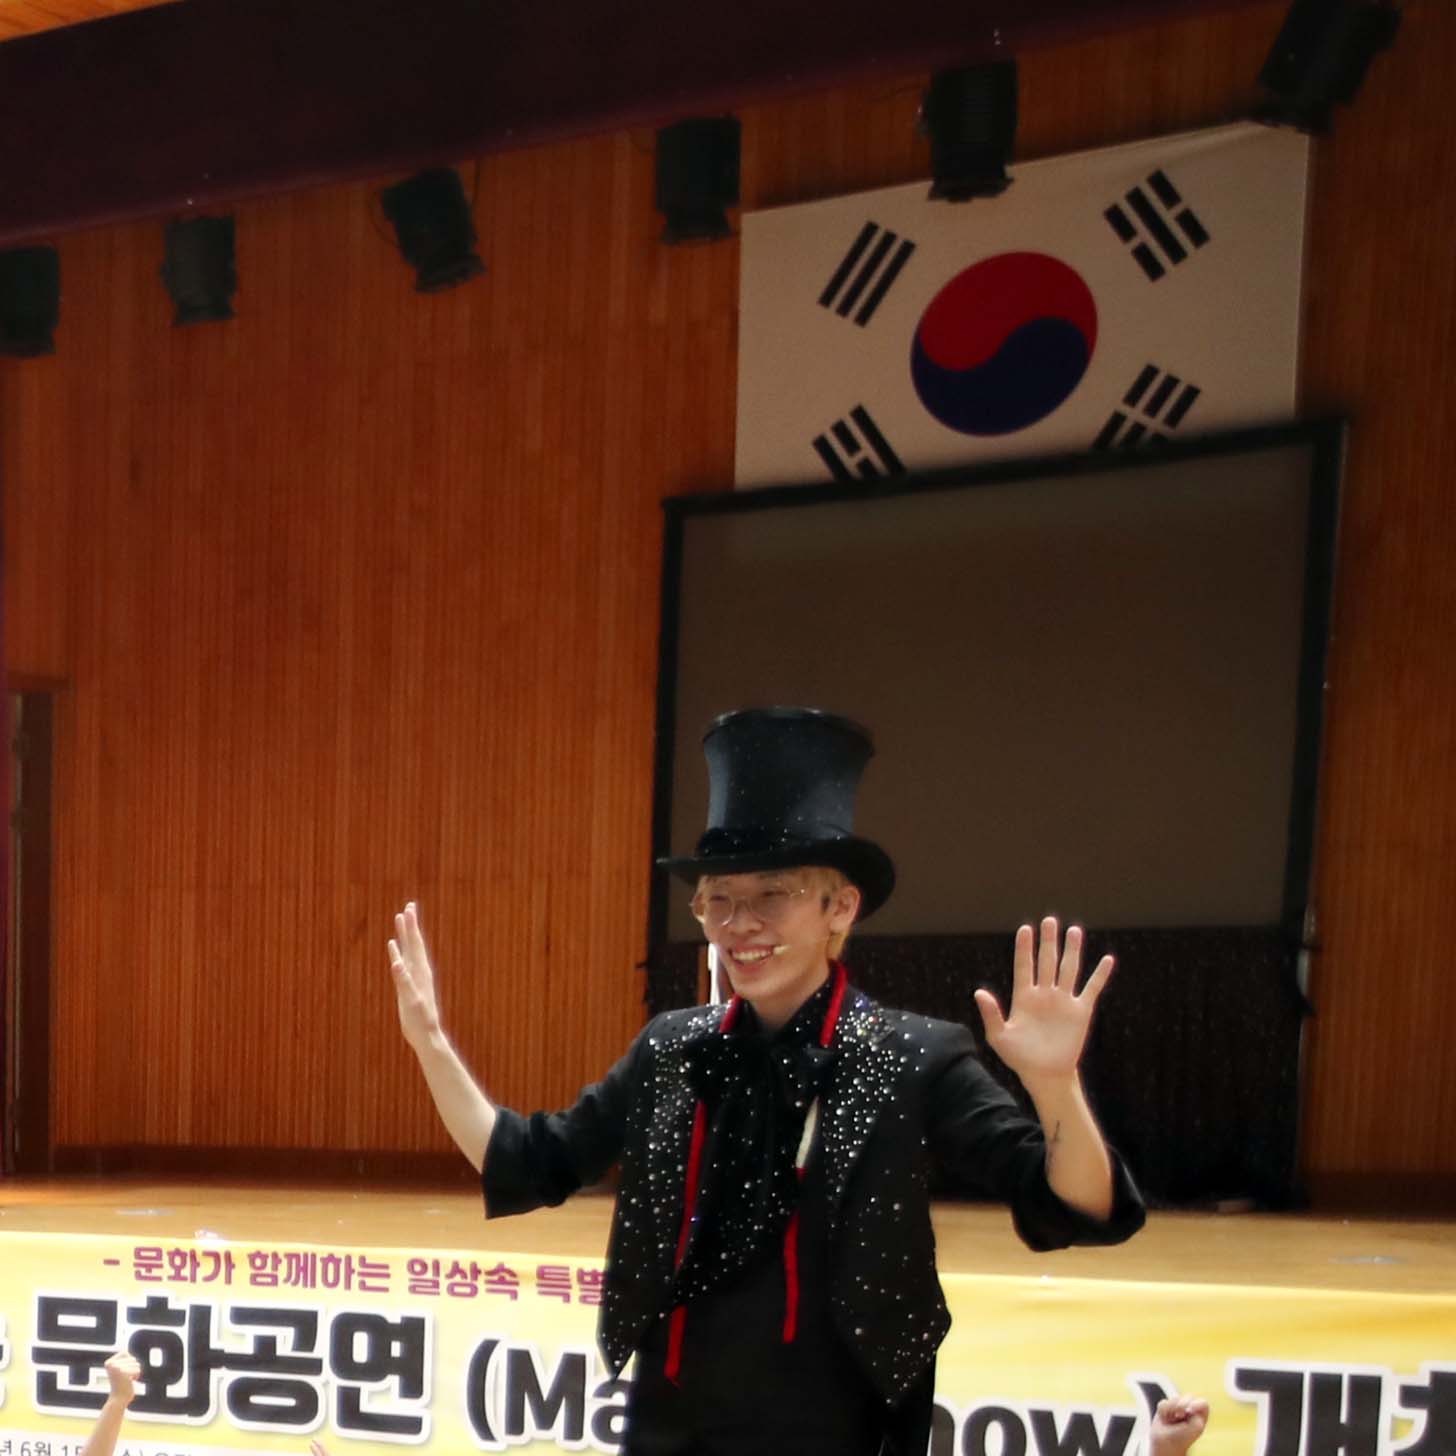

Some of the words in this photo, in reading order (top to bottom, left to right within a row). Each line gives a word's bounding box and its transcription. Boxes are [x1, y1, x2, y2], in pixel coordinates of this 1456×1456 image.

[133, 1246, 236, 1285] 문화가
[247, 1251, 391, 1293] 함께하는
[407, 1257, 520, 1301] 일상속
[31, 1295, 428, 1436] 문화공연
[466, 1338, 636, 1443] (Ma
